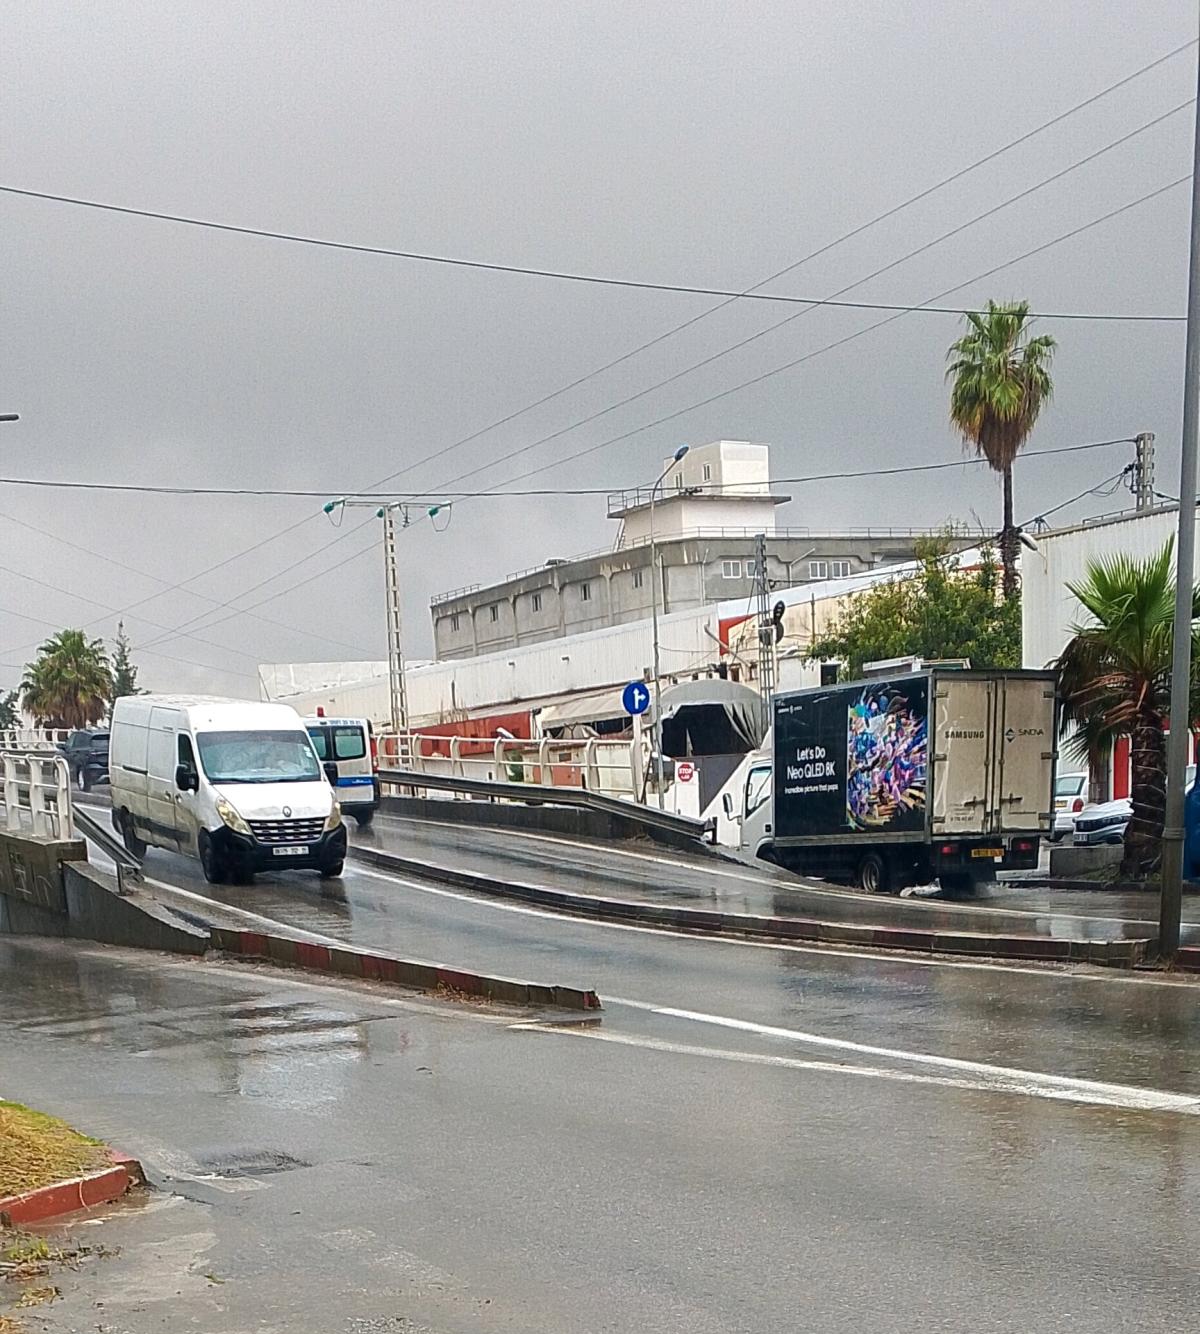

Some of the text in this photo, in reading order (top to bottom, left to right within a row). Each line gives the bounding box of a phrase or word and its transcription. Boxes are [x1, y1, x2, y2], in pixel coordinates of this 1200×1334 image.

[945, 730, 985, 739] SAMSUNG
[796, 745, 826, 761] Let's Do
[679, 767, 692, 775] STOP
[787, 760, 836, 780] Neo QLED 8K
